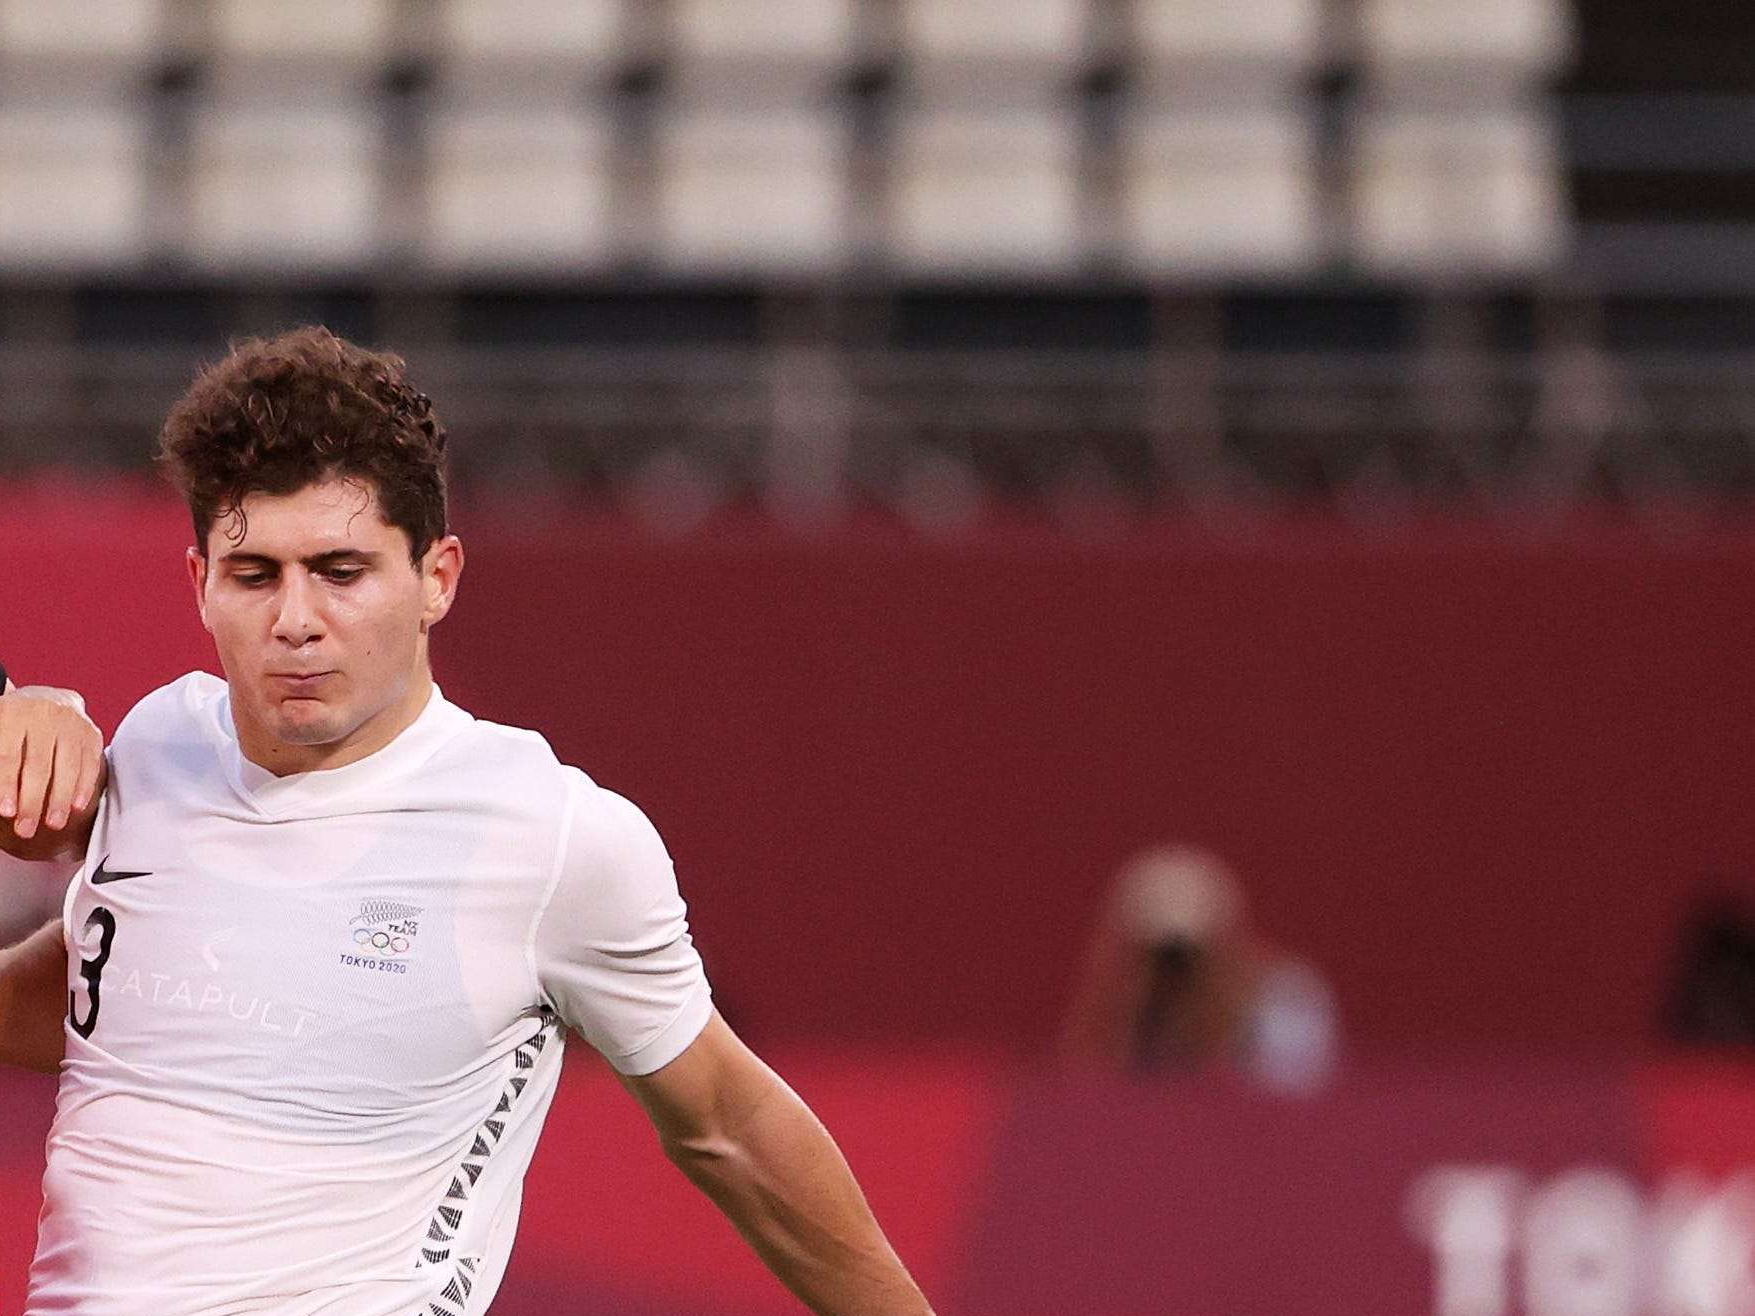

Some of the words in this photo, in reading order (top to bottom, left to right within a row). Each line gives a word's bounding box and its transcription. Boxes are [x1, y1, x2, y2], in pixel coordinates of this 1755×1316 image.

[69, 906, 116, 1040] 3
[339, 954, 376, 970] TOKYO
[378, 961, 407, 975] 2020
